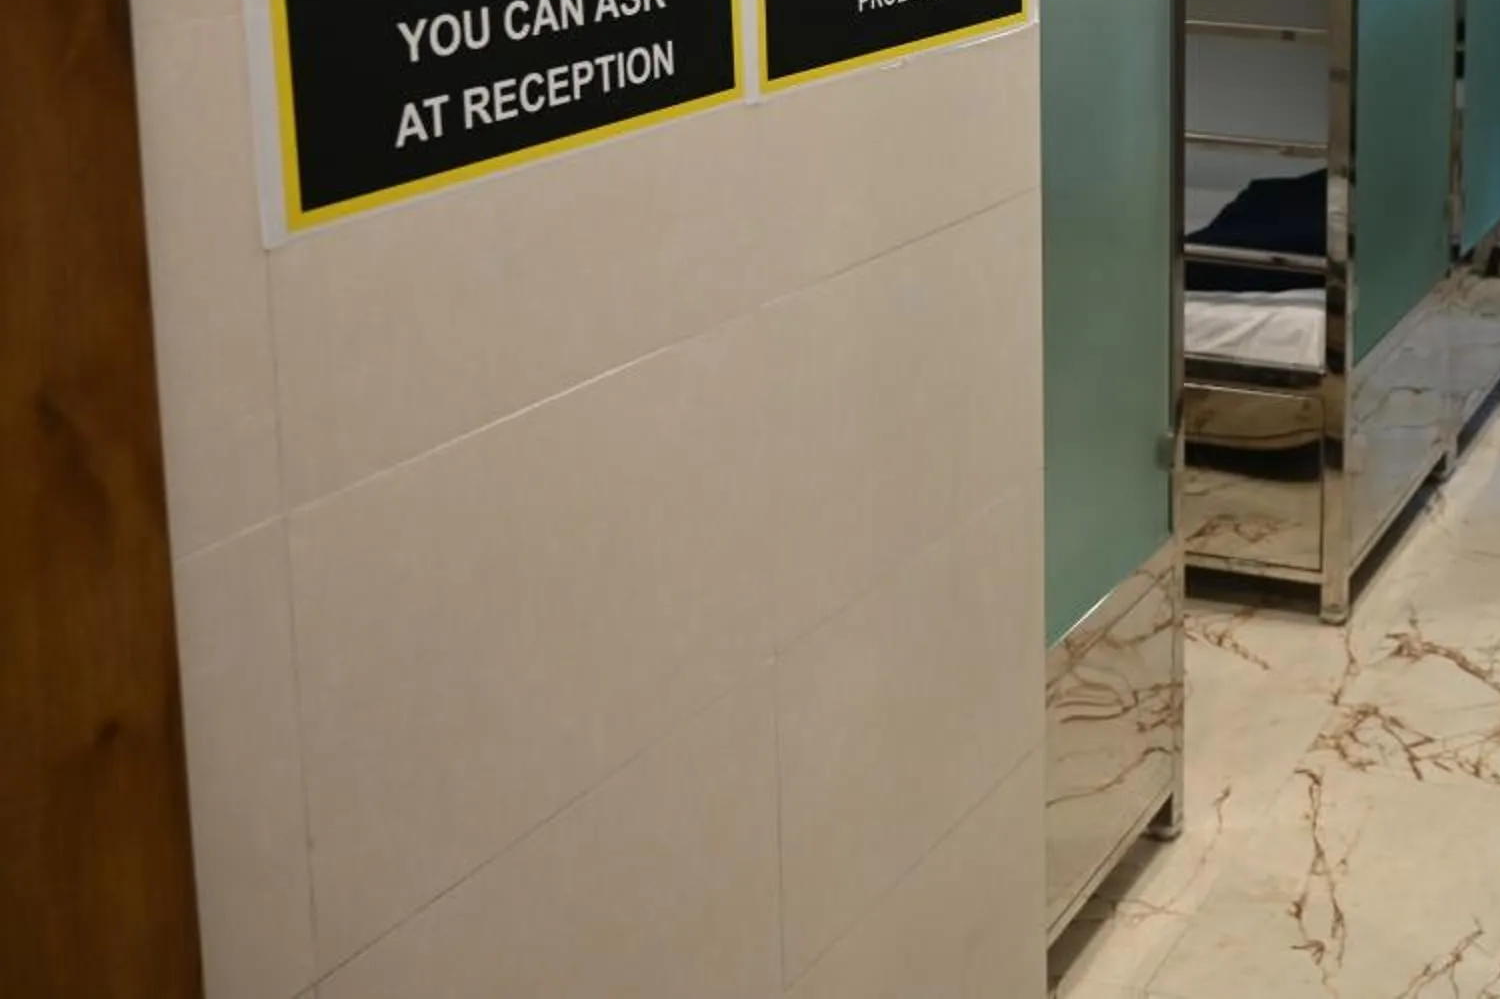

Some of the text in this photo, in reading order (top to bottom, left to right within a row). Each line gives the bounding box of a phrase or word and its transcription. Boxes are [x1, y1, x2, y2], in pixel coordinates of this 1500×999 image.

[397, 6, 491, 63] YOU
[395, 40, 676, 148] AT RECEPTION
